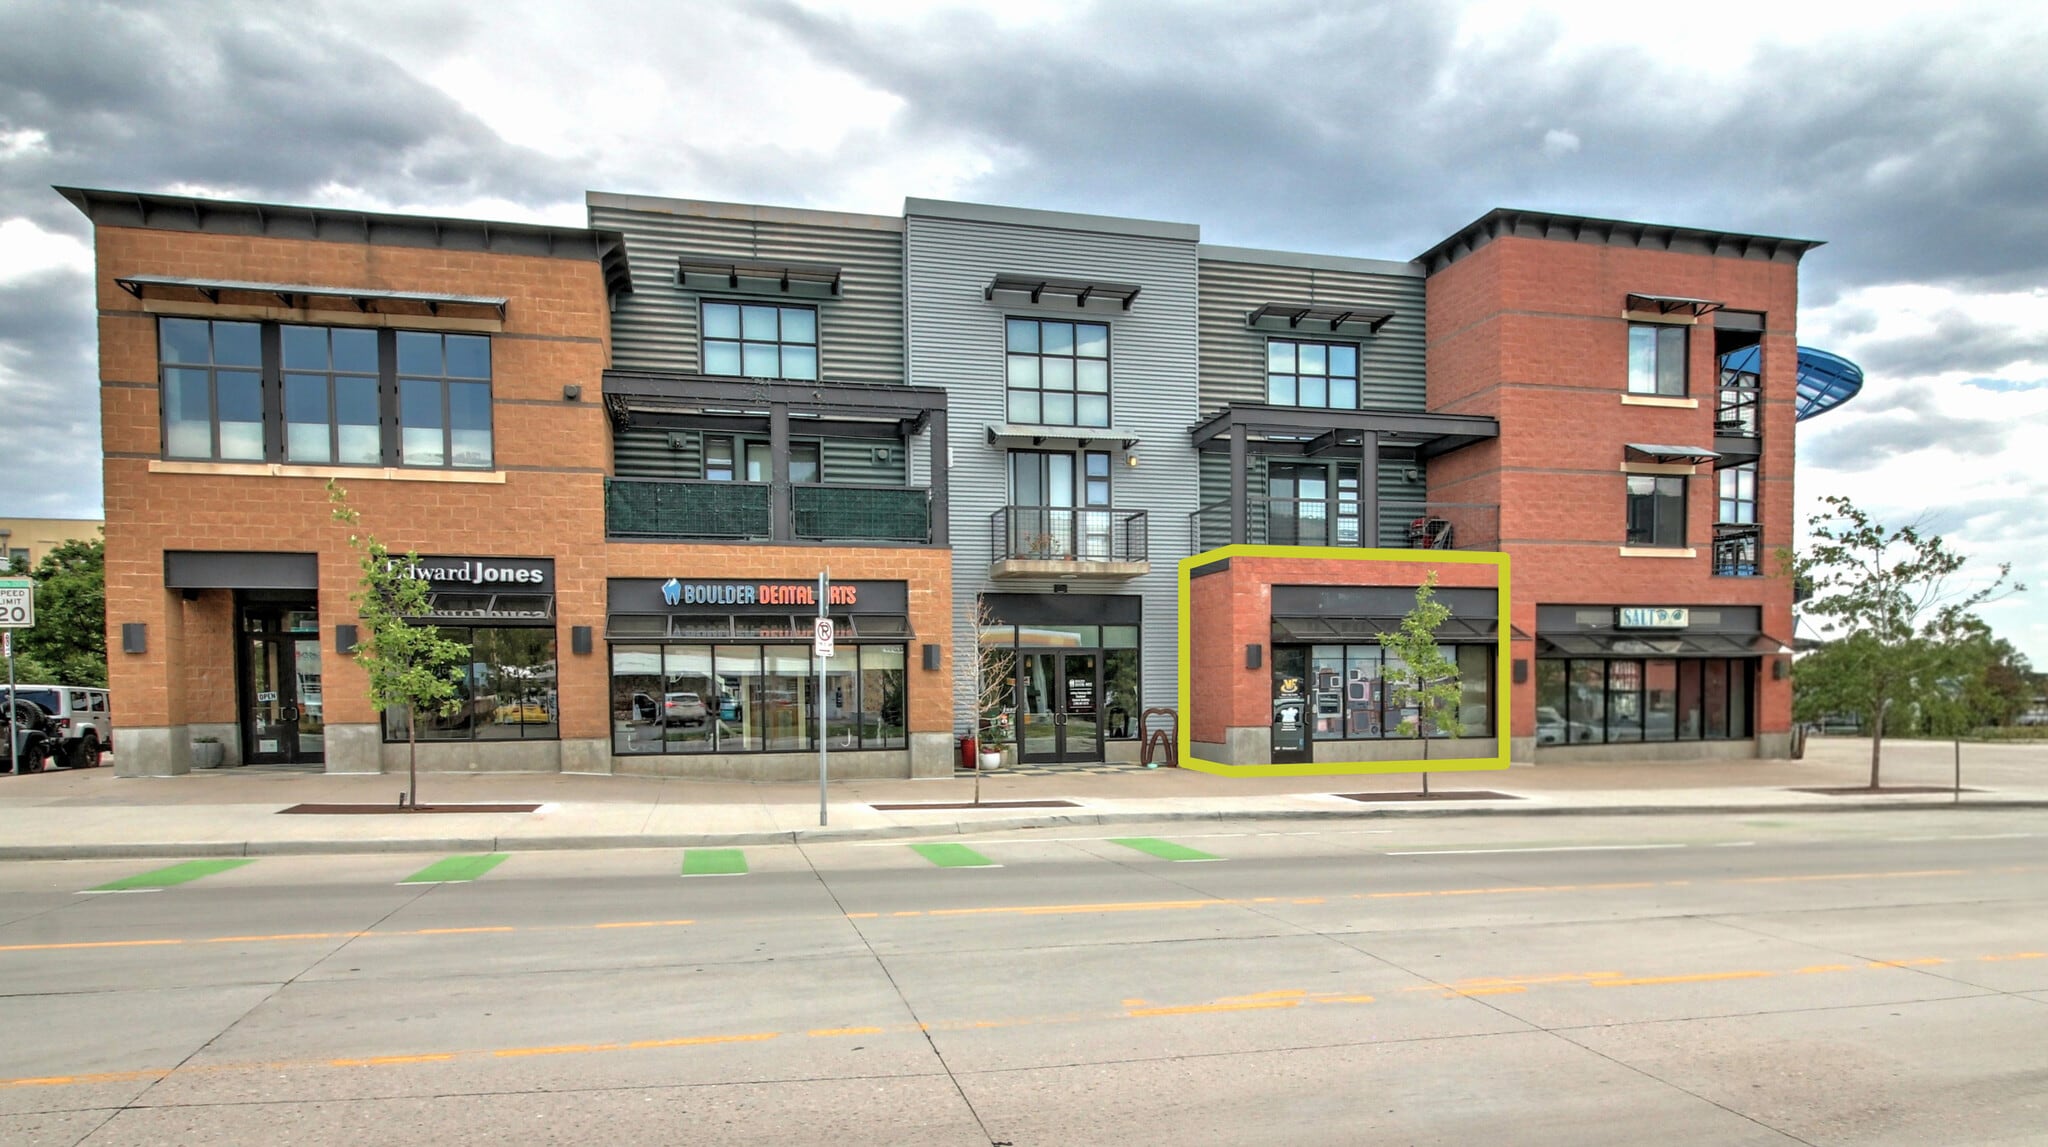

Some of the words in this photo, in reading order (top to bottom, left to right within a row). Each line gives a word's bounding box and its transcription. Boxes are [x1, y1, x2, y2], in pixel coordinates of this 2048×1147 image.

[473, 562, 544, 584] Jones
[685, 584, 755, 604] BOULDER
[759, 585, 815, 605] DENTAL
[828, 585, 857, 605] RTS
[0, 607, 25, 622] 20
[1624, 608, 1655, 625] SALT
[259, 693, 276, 701] OPEN
